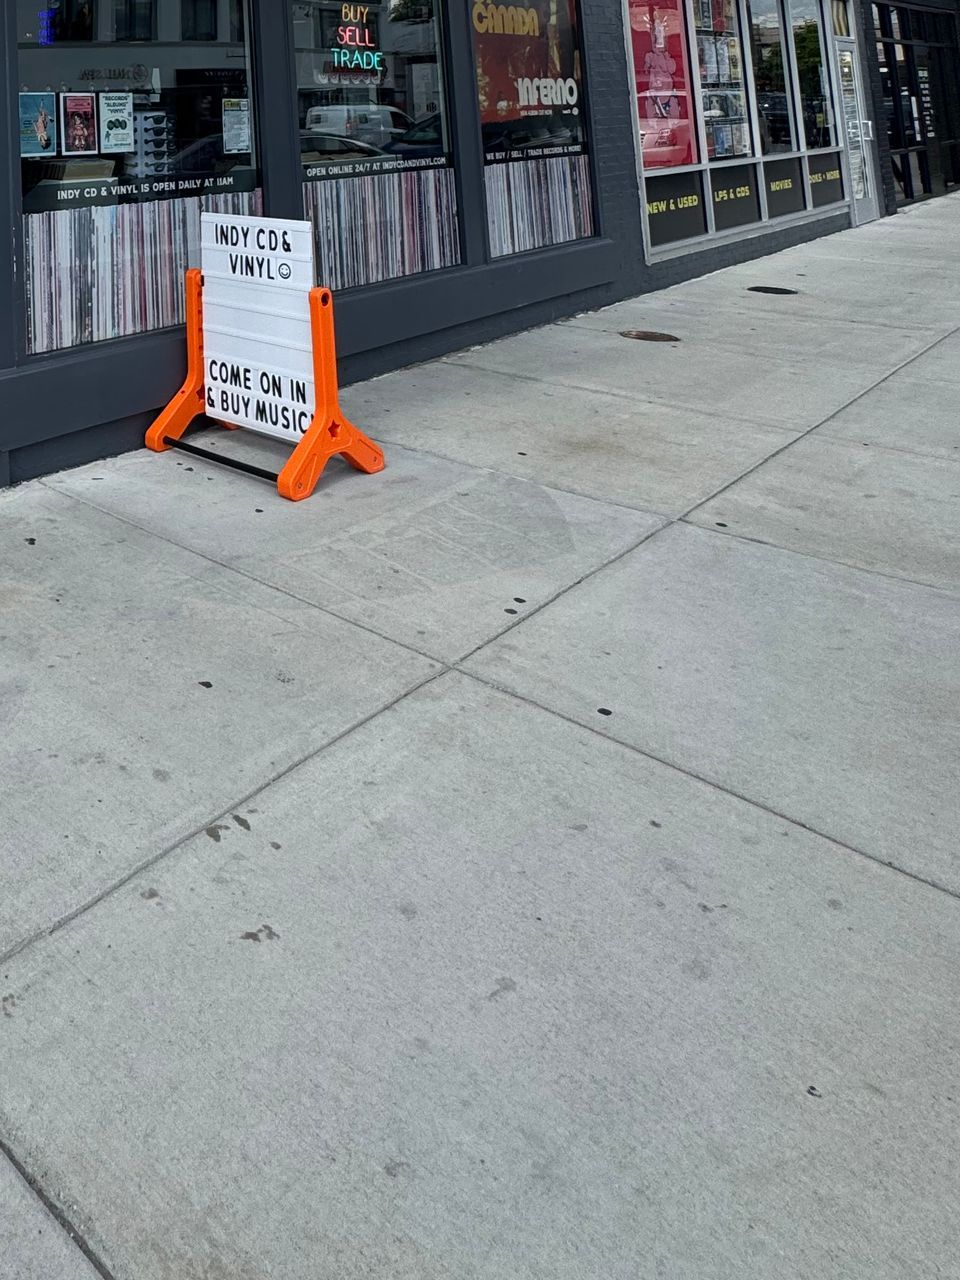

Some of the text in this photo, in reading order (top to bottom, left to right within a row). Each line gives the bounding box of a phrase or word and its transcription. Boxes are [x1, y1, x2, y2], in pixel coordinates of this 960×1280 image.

[341, 2, 369, 24] BUY
[472, 1, 540, 37] CANADA
[336, 26, 375, 47] SELL
[330, 47, 384, 70] TRADE
[517, 77, 578, 106] INFERNO
[306, 162, 380, 177] OPEN ONLINE 24/7 AT
[57, 178, 214, 200] INDY CD & VINYL IS OPEN DAILY AT
[714, 185, 750, 202] LPS CDS
[770, 178, 792, 192] MOVIES
[646, 195, 699, 215] NEW USED
[214, 223, 292, 253] INDY CD &
[229, 253, 275, 280] VINYL
[209, 359, 307, 405] COME ON IN
[206, 387, 250, 419] & BUY
